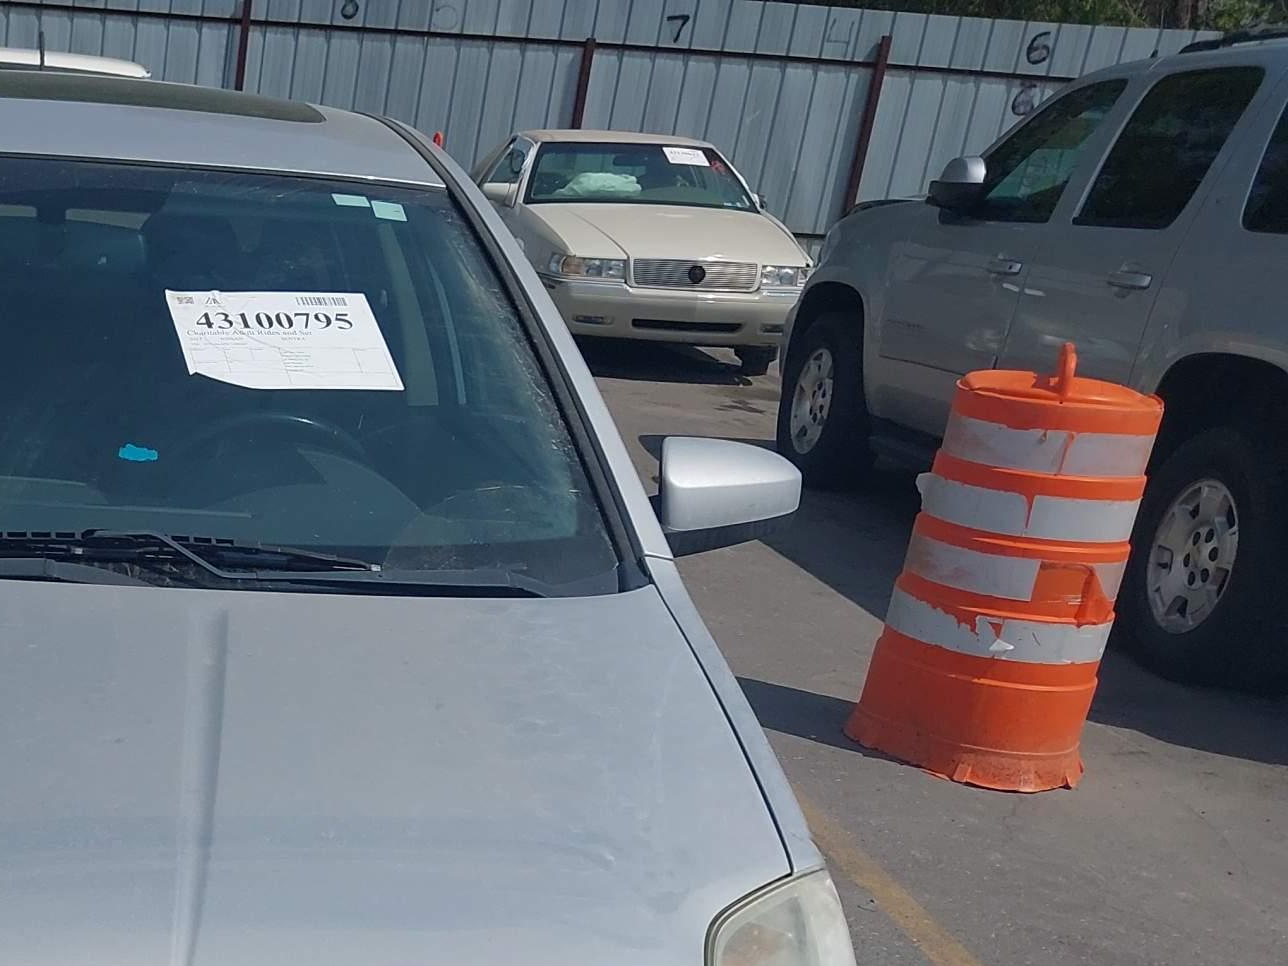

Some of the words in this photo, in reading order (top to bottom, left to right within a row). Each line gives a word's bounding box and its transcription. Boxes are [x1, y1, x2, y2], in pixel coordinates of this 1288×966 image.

[666, 14, 690, 43] 7
[1026, 31, 1051, 65] 6
[196, 312, 353, 330] 43100795
